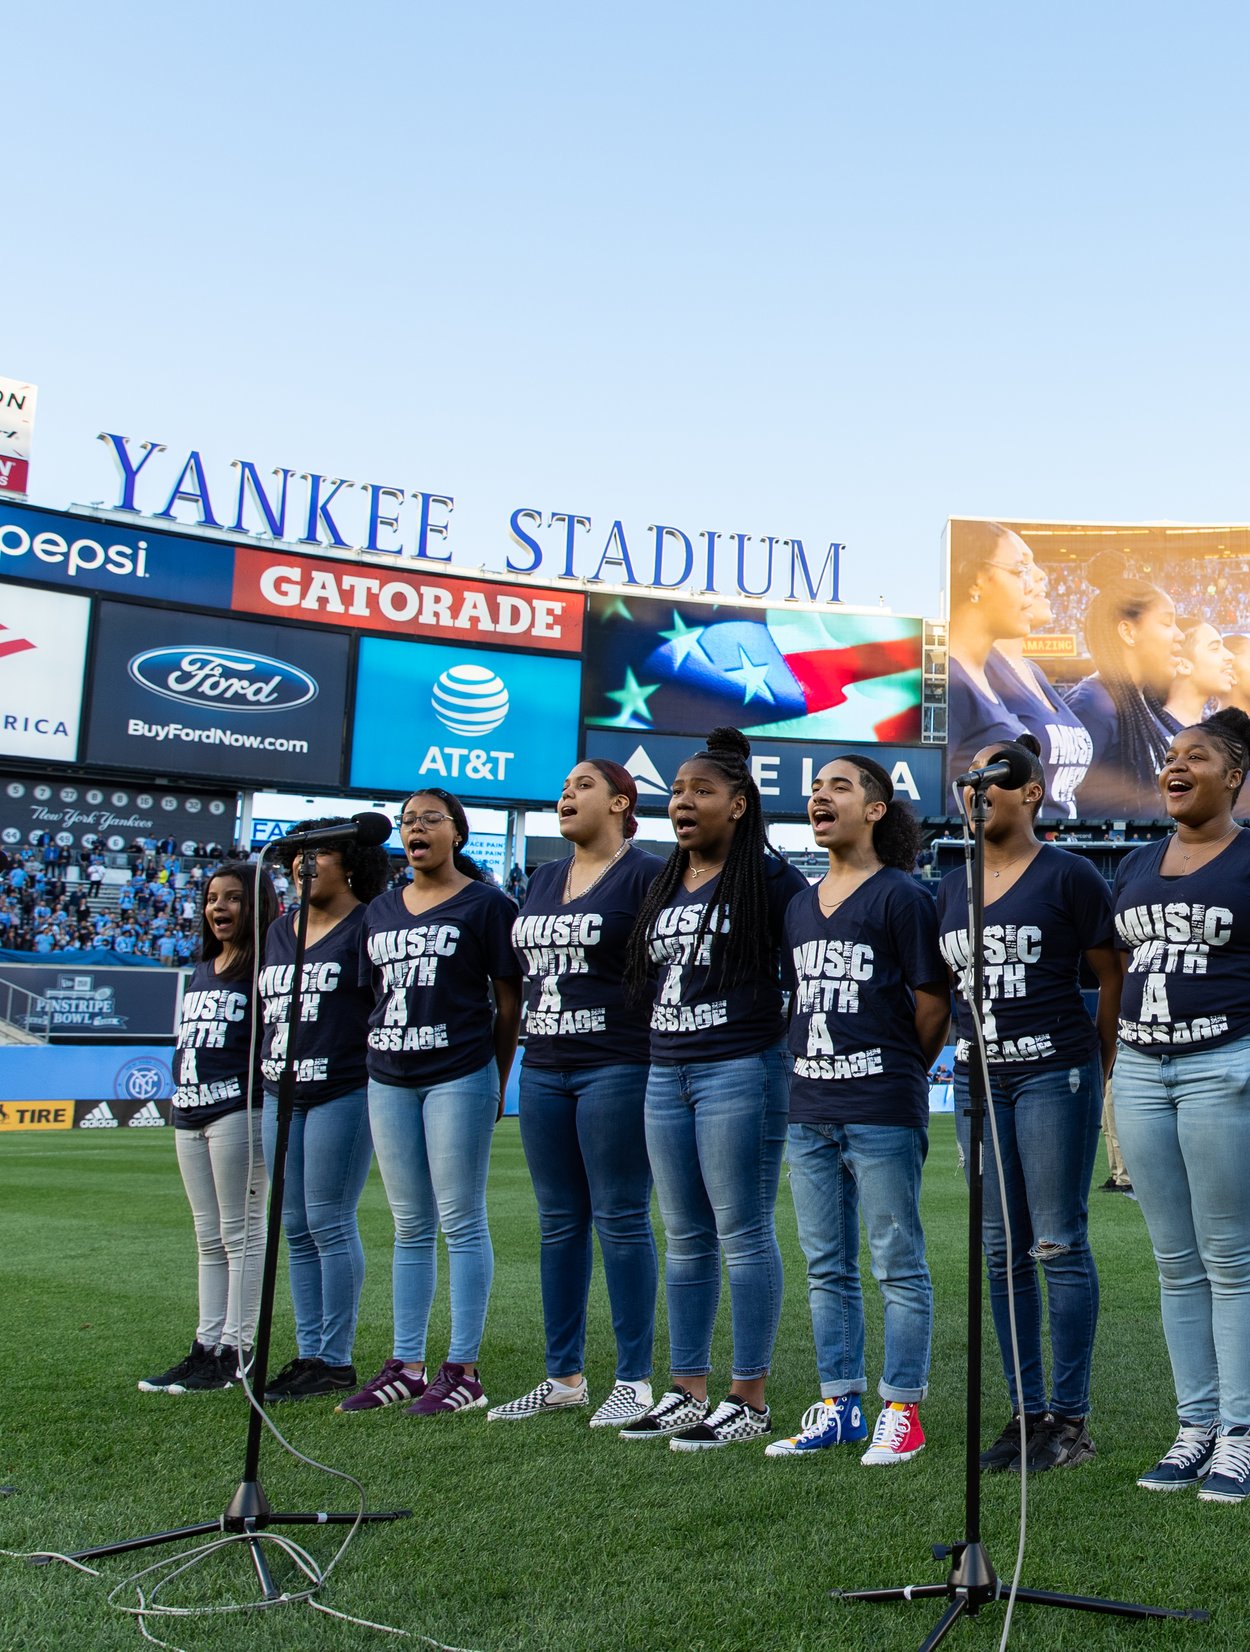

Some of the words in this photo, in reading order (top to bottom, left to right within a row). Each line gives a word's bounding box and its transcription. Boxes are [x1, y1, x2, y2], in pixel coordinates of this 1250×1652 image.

[97, 431, 456, 563] YANKEE
[506, 507, 847, 604] STADIUM
[260, 565, 563, 638] GATORADE
[167, 654, 282, 703] Ford
[128, 719, 309, 753] BuyFordNow.com
[418, 746, 515, 781] AT&T
[30, 806, 64, 821] New
[62, 809, 97, 829] York
[97, 812, 153, 830] Yankees
[511, 913, 603, 948] MUSIC
[1114, 902, 1234, 947] MUSIC
[367, 924, 460, 966] MUSIC
[523, 947, 589, 976] WITH
[649, 934, 713, 965] WITH
[1128, 940, 1210, 974] WITH
[380, 957, 438, 993] WITH
[793, 940, 875, 986] MUSIC
[537, 975, 562, 1012] A
[660, 965, 683, 1006] A
[796, 979, 859, 1015] WITH
[1139, 973, 1171, 1022] A
[36, 999, 113, 1013] PINSTRIPE
[53, 1012, 92, 1024] BOWL
[182, 990, 248, 1021] MUSIC
[384, 987, 407, 1026] A
[176, 1021, 229, 1050] WITH
[807, 1012, 834, 1057] A
[1117, 1013, 1229, 1046] MESSAGE
[180, 1048, 199, 1084] A
[793, 1047, 884, 1080] MESSAGE
[16, 1108, 67, 1124] TIRE
[80, 1119, 118, 1129] adidas
[128, 1117, 166, 1127] adidas
